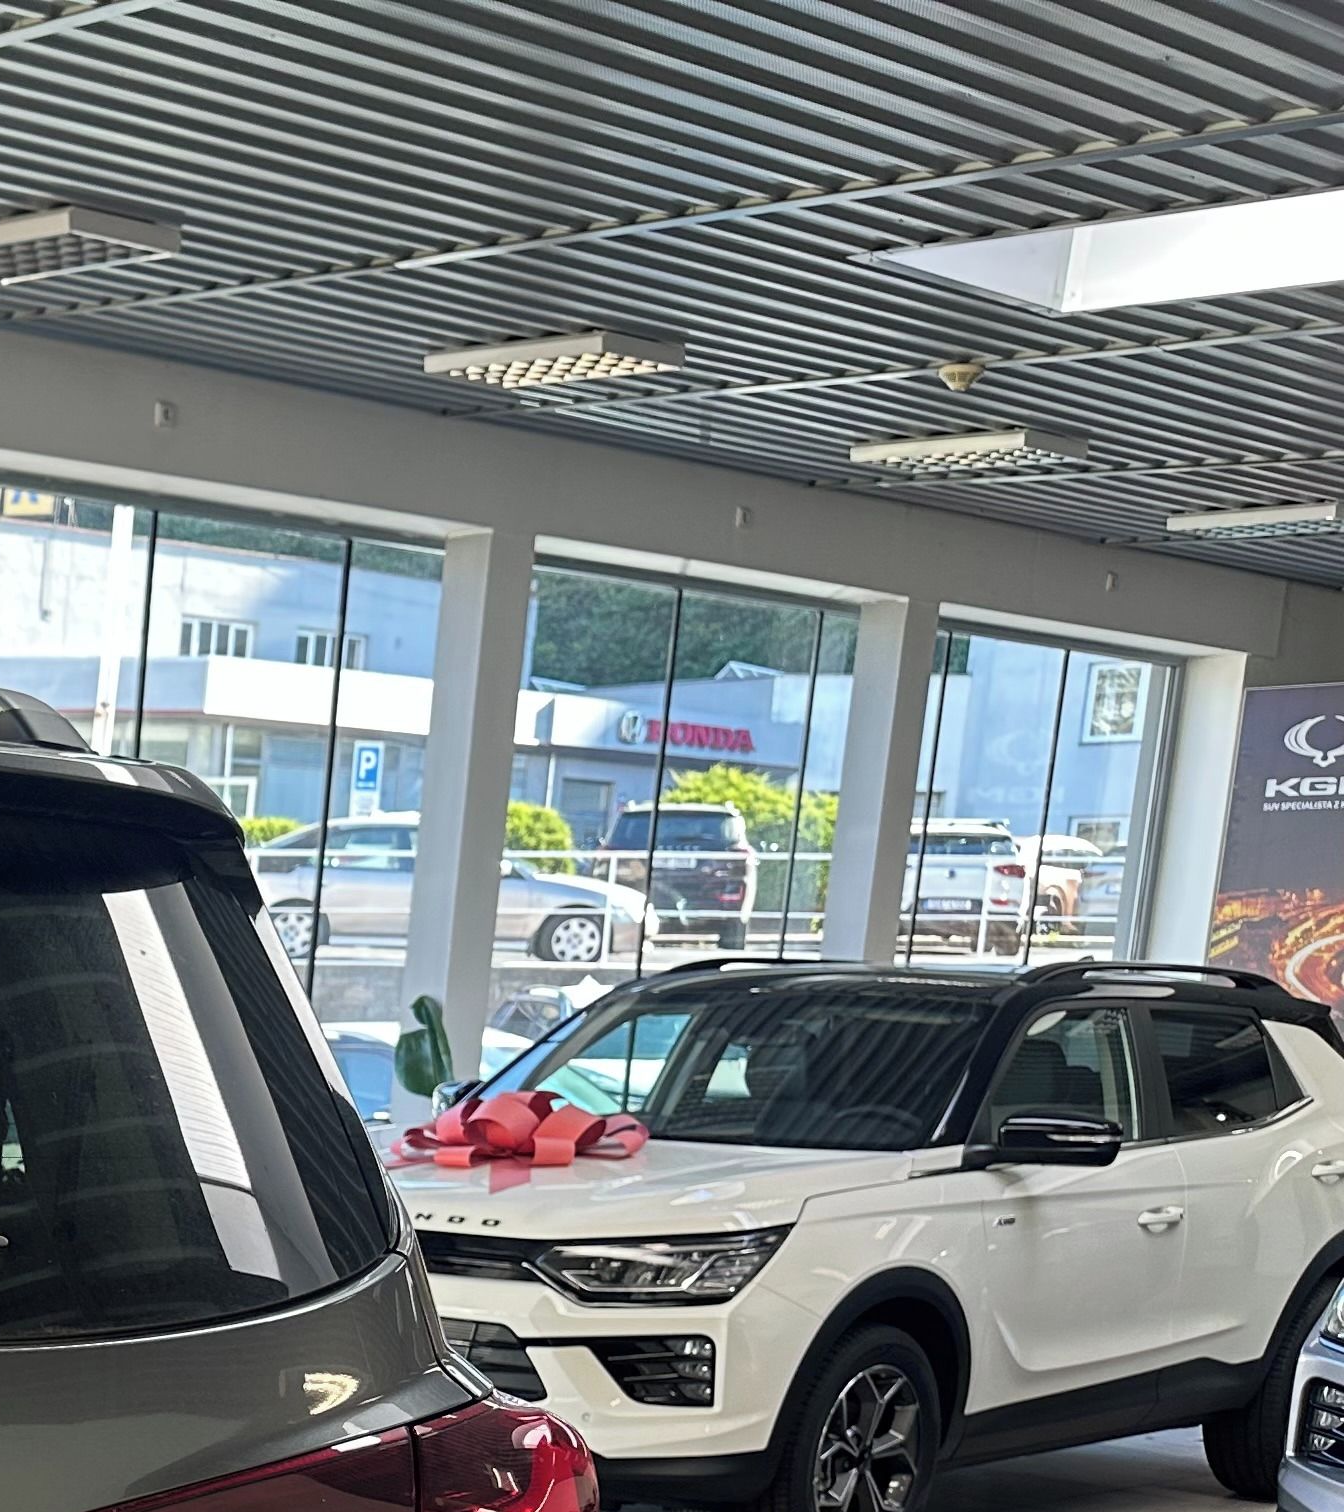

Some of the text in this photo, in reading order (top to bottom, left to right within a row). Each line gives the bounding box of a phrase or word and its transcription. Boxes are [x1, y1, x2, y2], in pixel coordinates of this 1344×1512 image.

[646, 719, 757, 754] HONDA
[359, 750, 378, 780] P
[1264, 776, 1344, 798] KG
